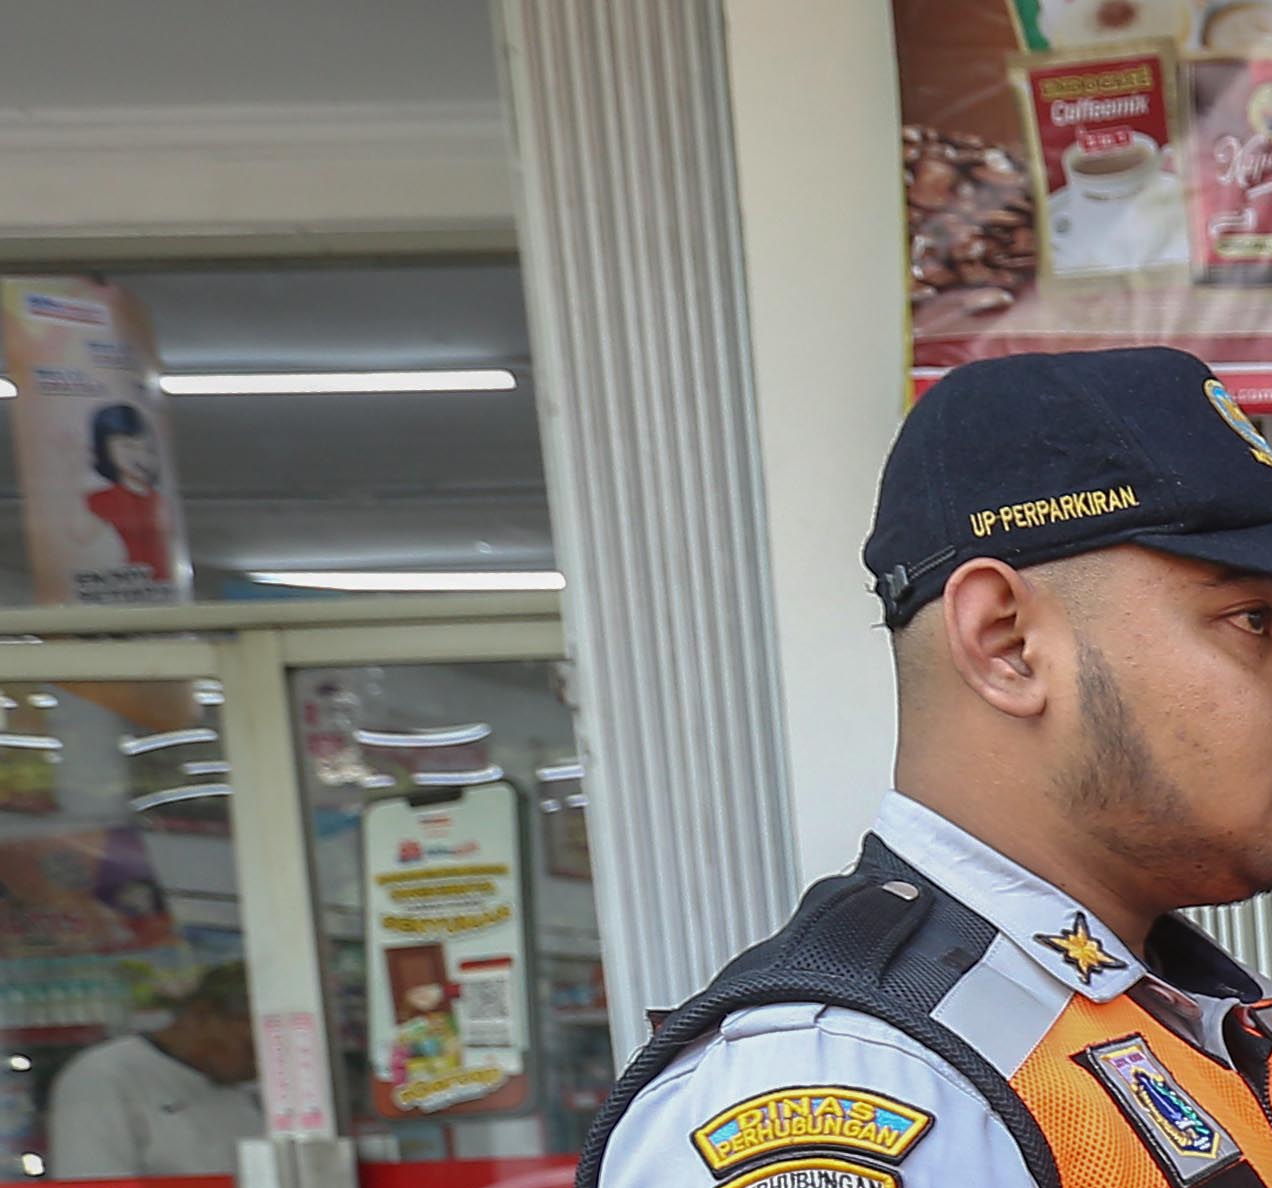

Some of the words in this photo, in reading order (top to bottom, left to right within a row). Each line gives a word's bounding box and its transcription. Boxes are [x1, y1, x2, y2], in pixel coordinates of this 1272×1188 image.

[969, 510, 997, 537] UP
[999, 485, 1138, 531] PERPARKIRAN
[716, 1114, 899, 1158] PERHUBUNGAN
[736, 1097, 876, 1131] DINAS
